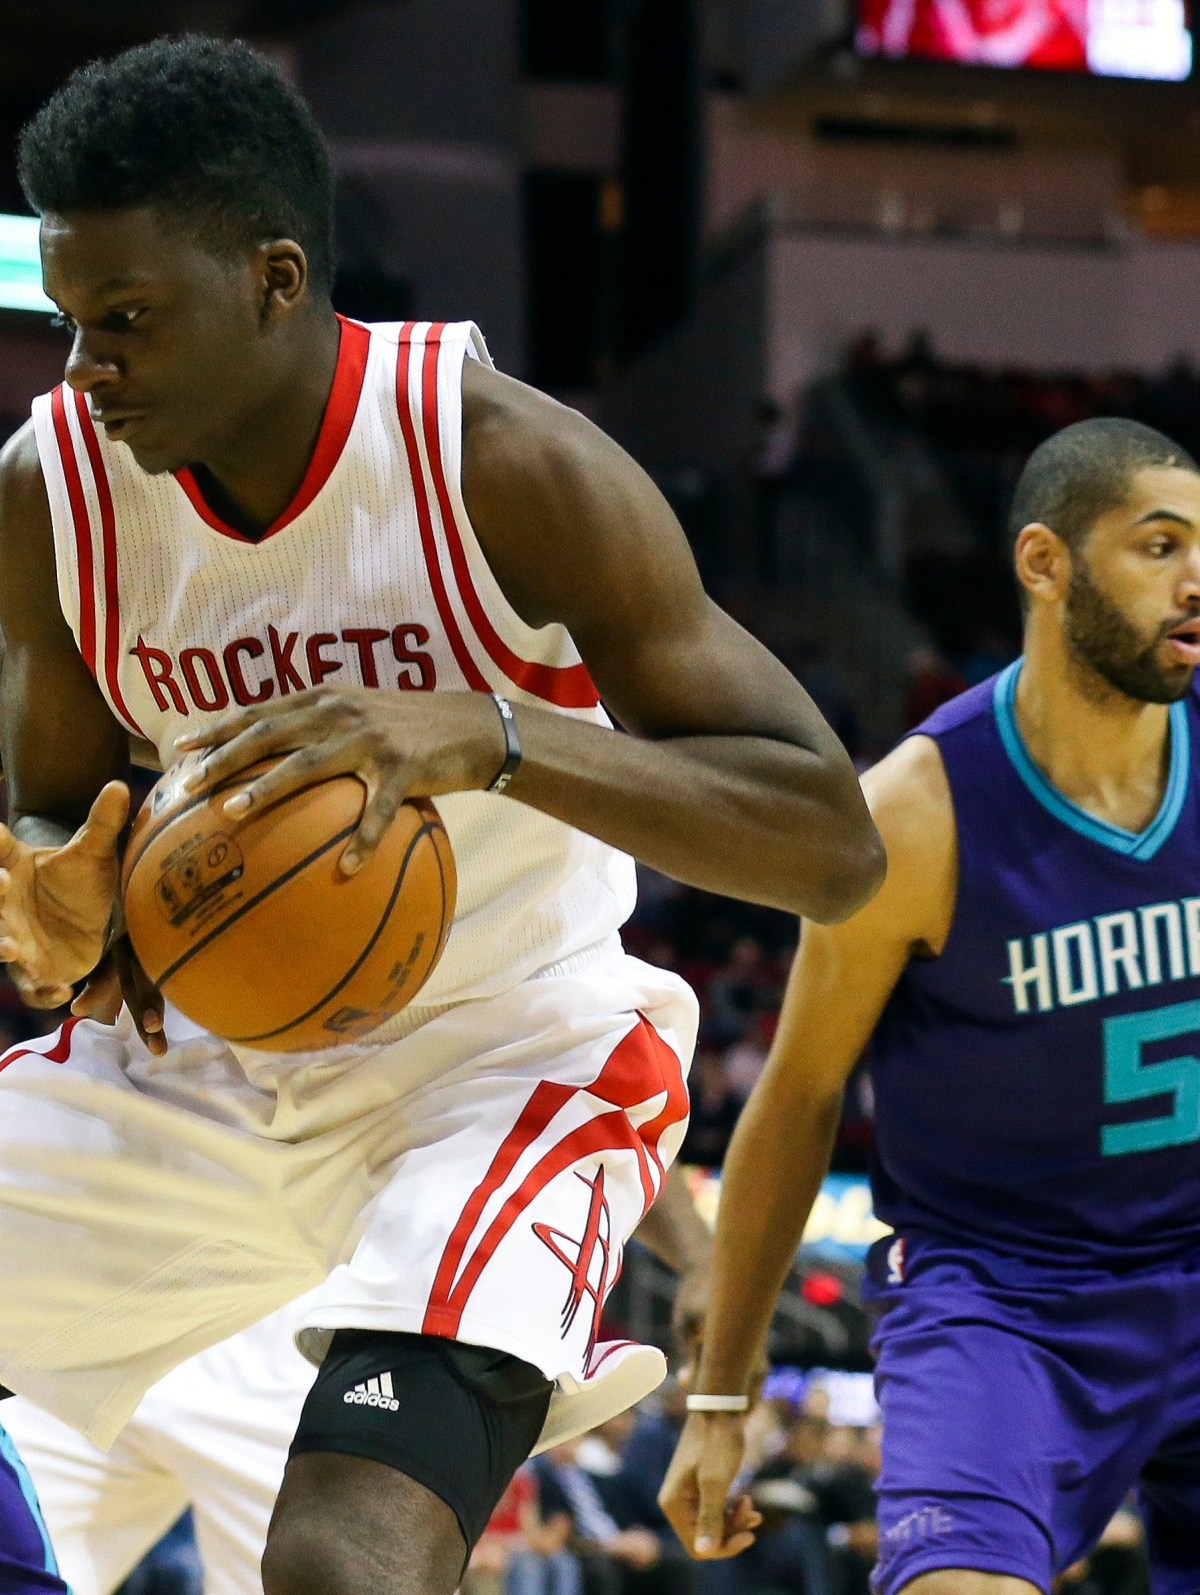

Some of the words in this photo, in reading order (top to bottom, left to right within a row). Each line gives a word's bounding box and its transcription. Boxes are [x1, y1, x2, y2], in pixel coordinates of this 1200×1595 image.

[129, 623, 437, 717] ROCKETS
[1101, 1000, 1200, 1157] 5
[343, 1390, 400, 1412] adidas
